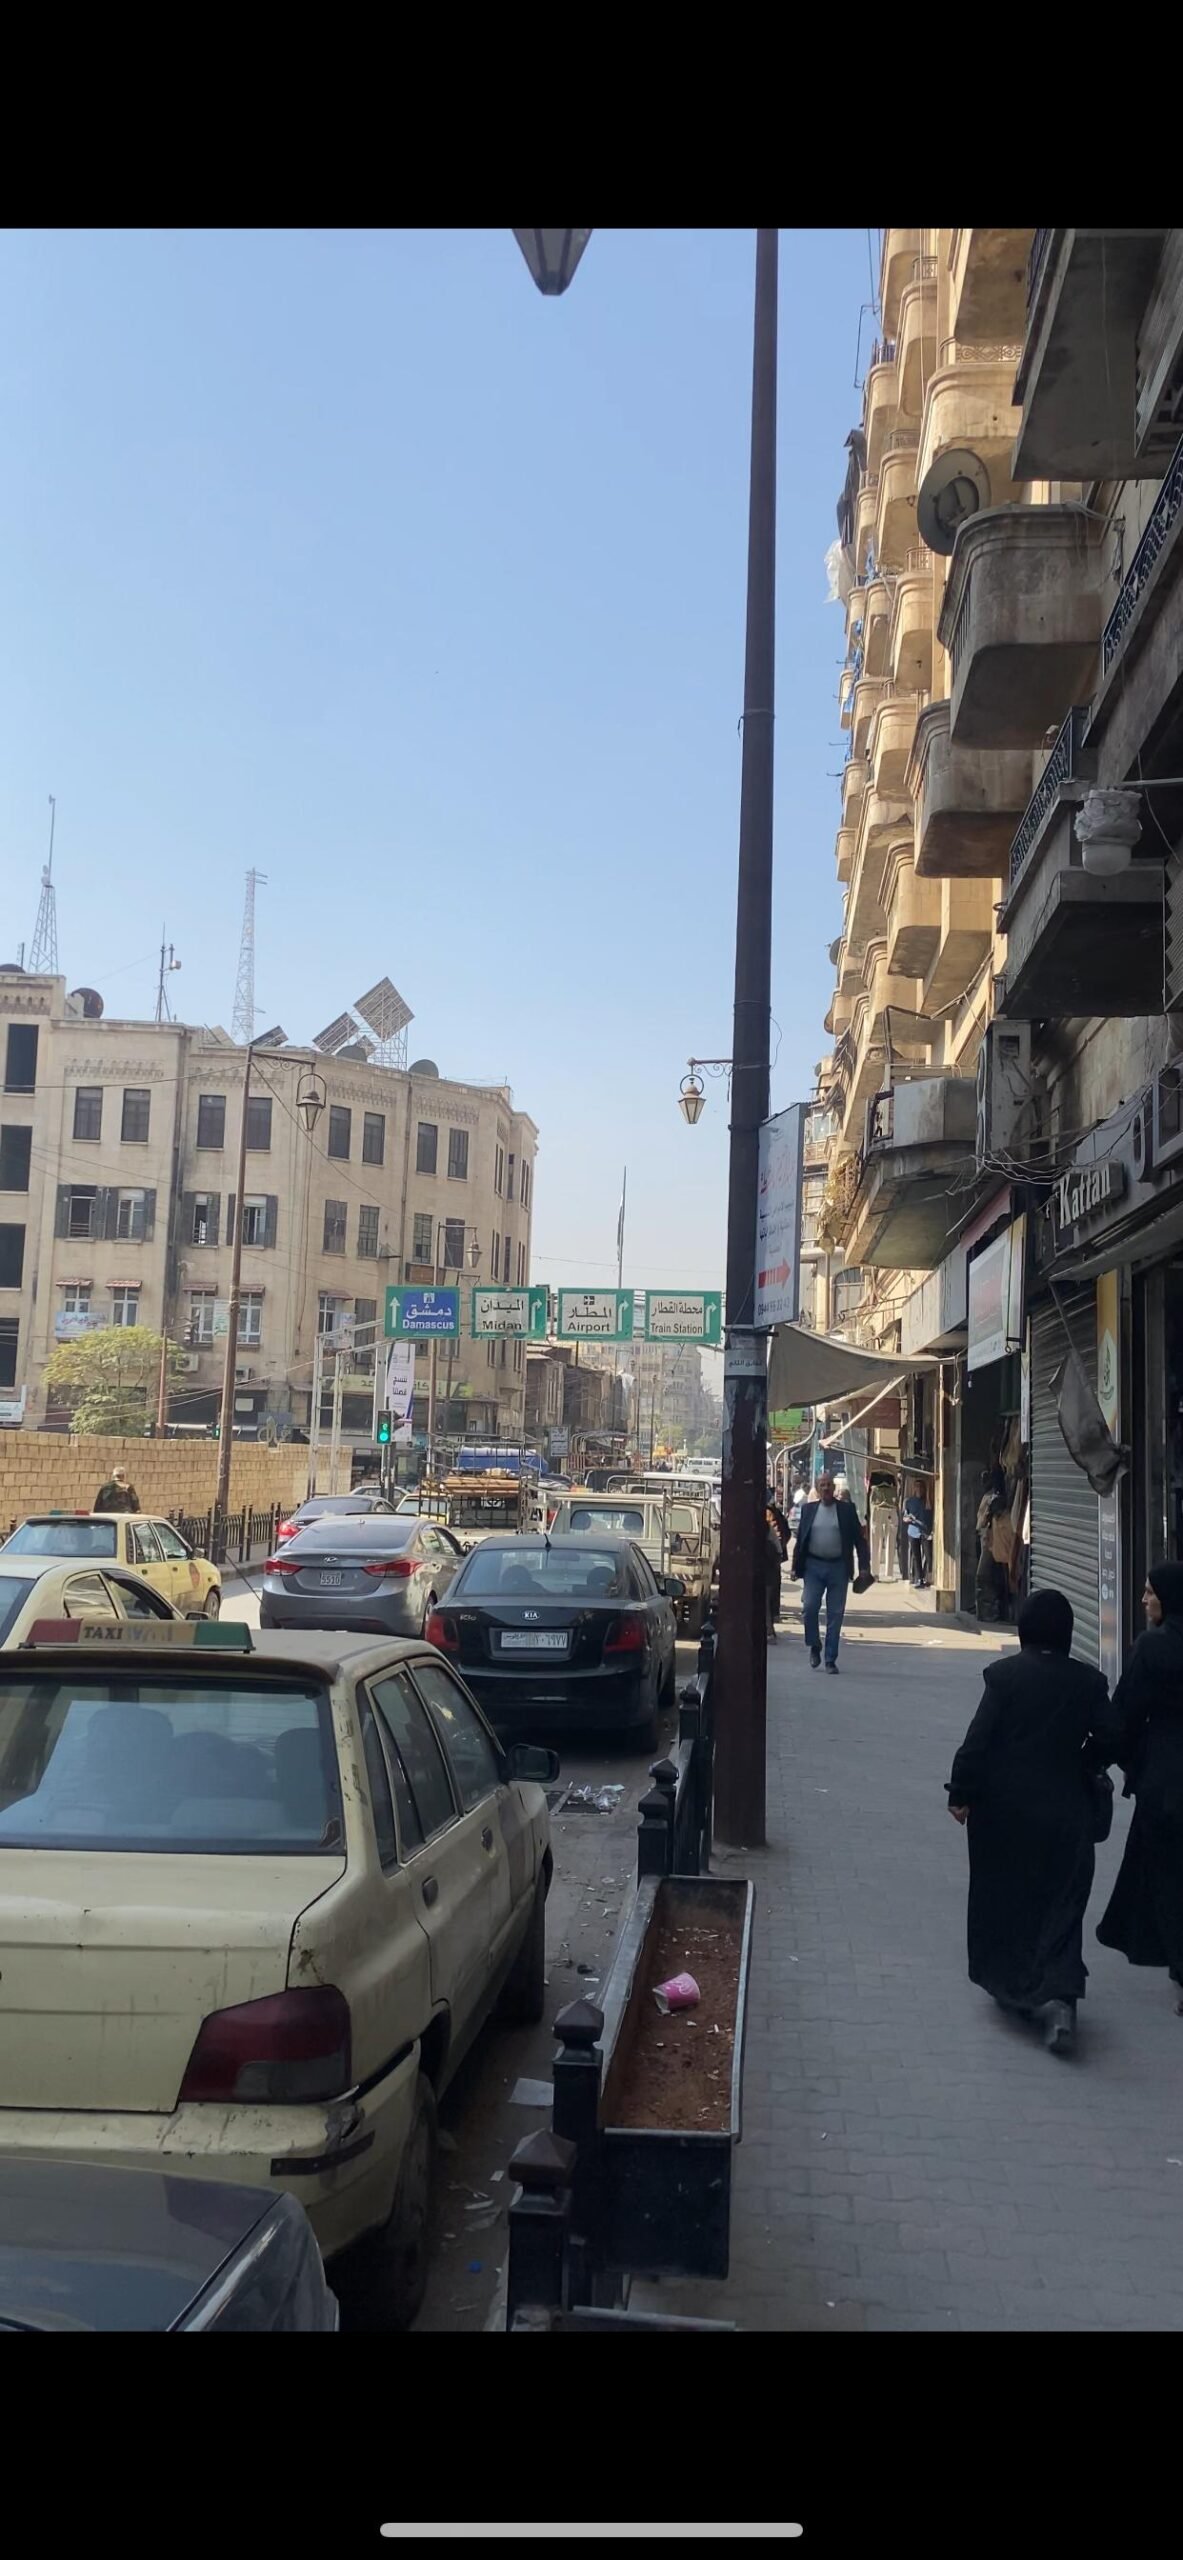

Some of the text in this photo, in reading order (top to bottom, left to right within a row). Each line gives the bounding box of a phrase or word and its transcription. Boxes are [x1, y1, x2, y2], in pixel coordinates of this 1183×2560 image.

[1059, 1165, 1111, 1230] Kattan
[406, 1304, 452, 1319] دمشق
[480, 1298, 524, 1313] الميدان
[651, 1301, 703, 1316] محطة القطار
[567, 1306, 612, 1319] المطار
[402, 1320, 455, 1330] Damascus
[482, 1320, 522, 1331] Midan
[567, 1322, 611, 1333] Airport
[651, 1322, 703, 1335] Train Station
[524, 1611, 538, 1619] KIA
[83, 1626, 124, 1640] TAXI
